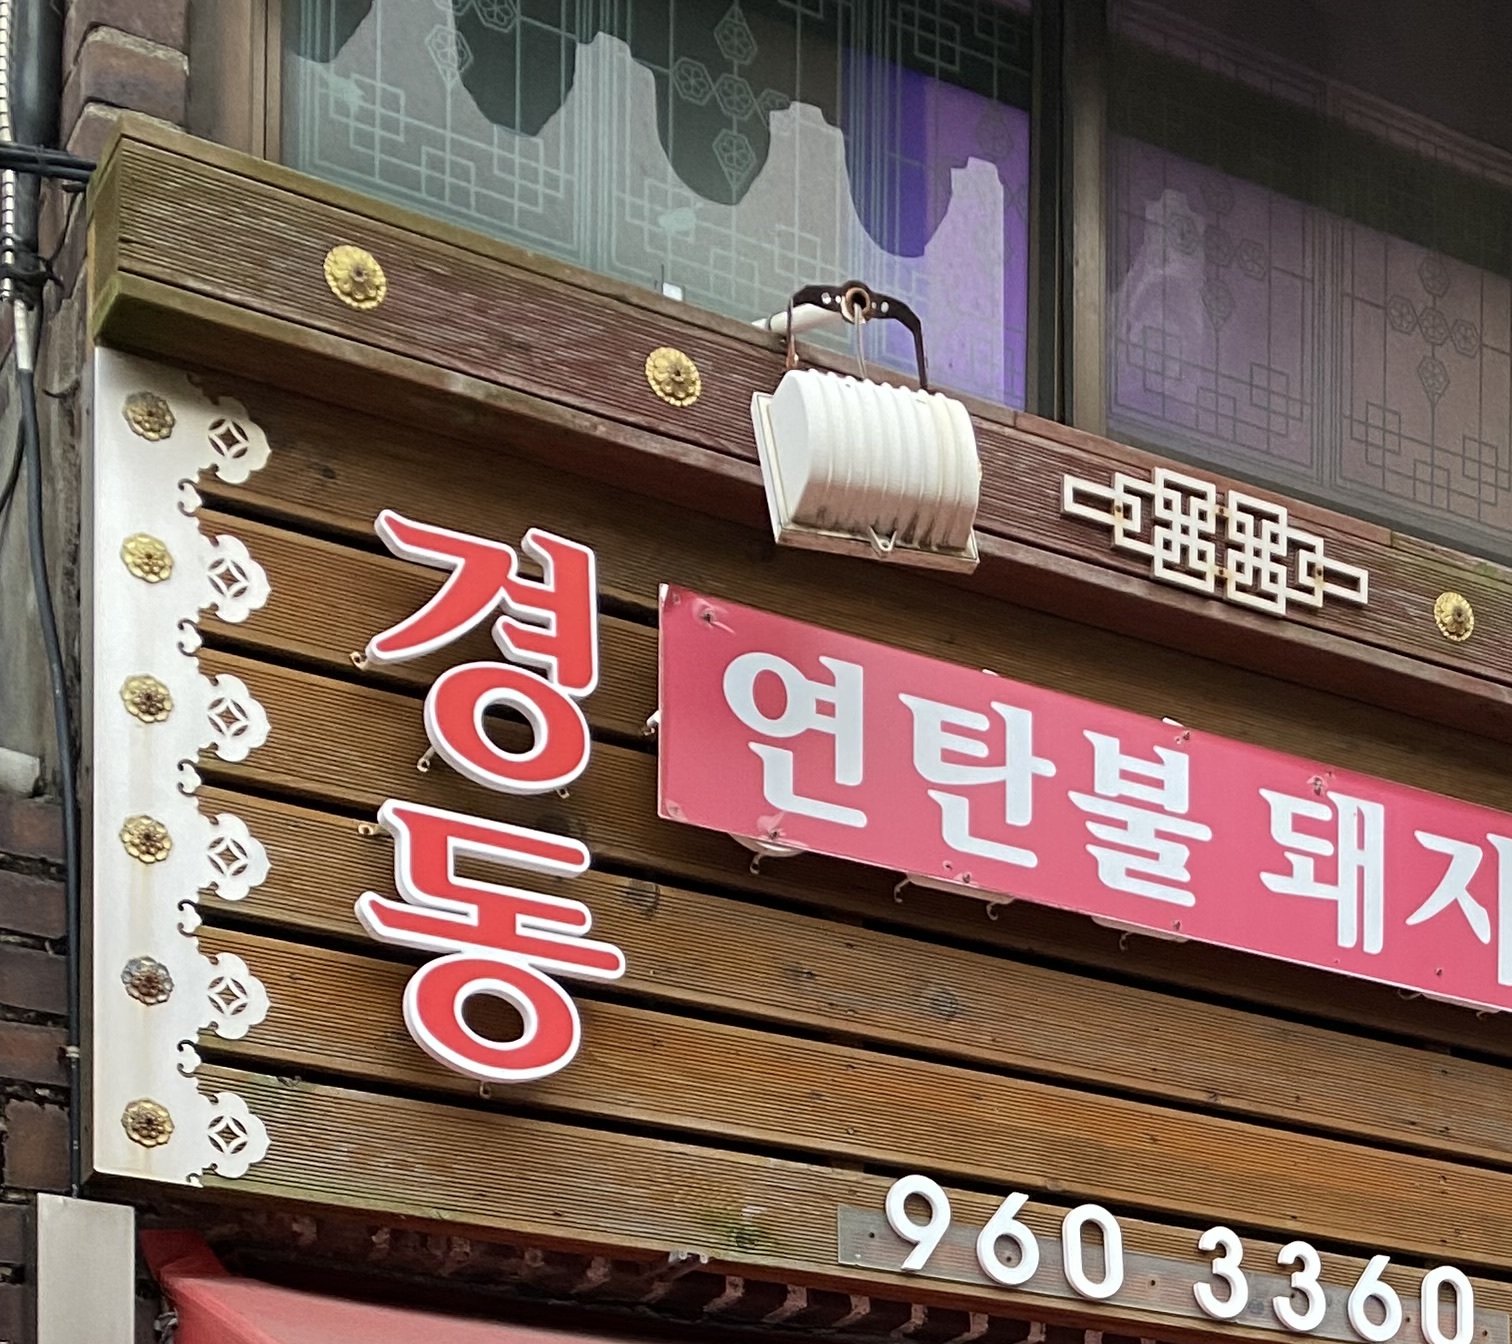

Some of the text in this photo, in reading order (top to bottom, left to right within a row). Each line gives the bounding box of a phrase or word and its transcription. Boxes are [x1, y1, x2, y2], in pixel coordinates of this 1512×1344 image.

[354, 508, 628, 1083] 경동
[721, 651, 1213, 907] 연탄불
[884, 1173, 1126, 1301] 960
